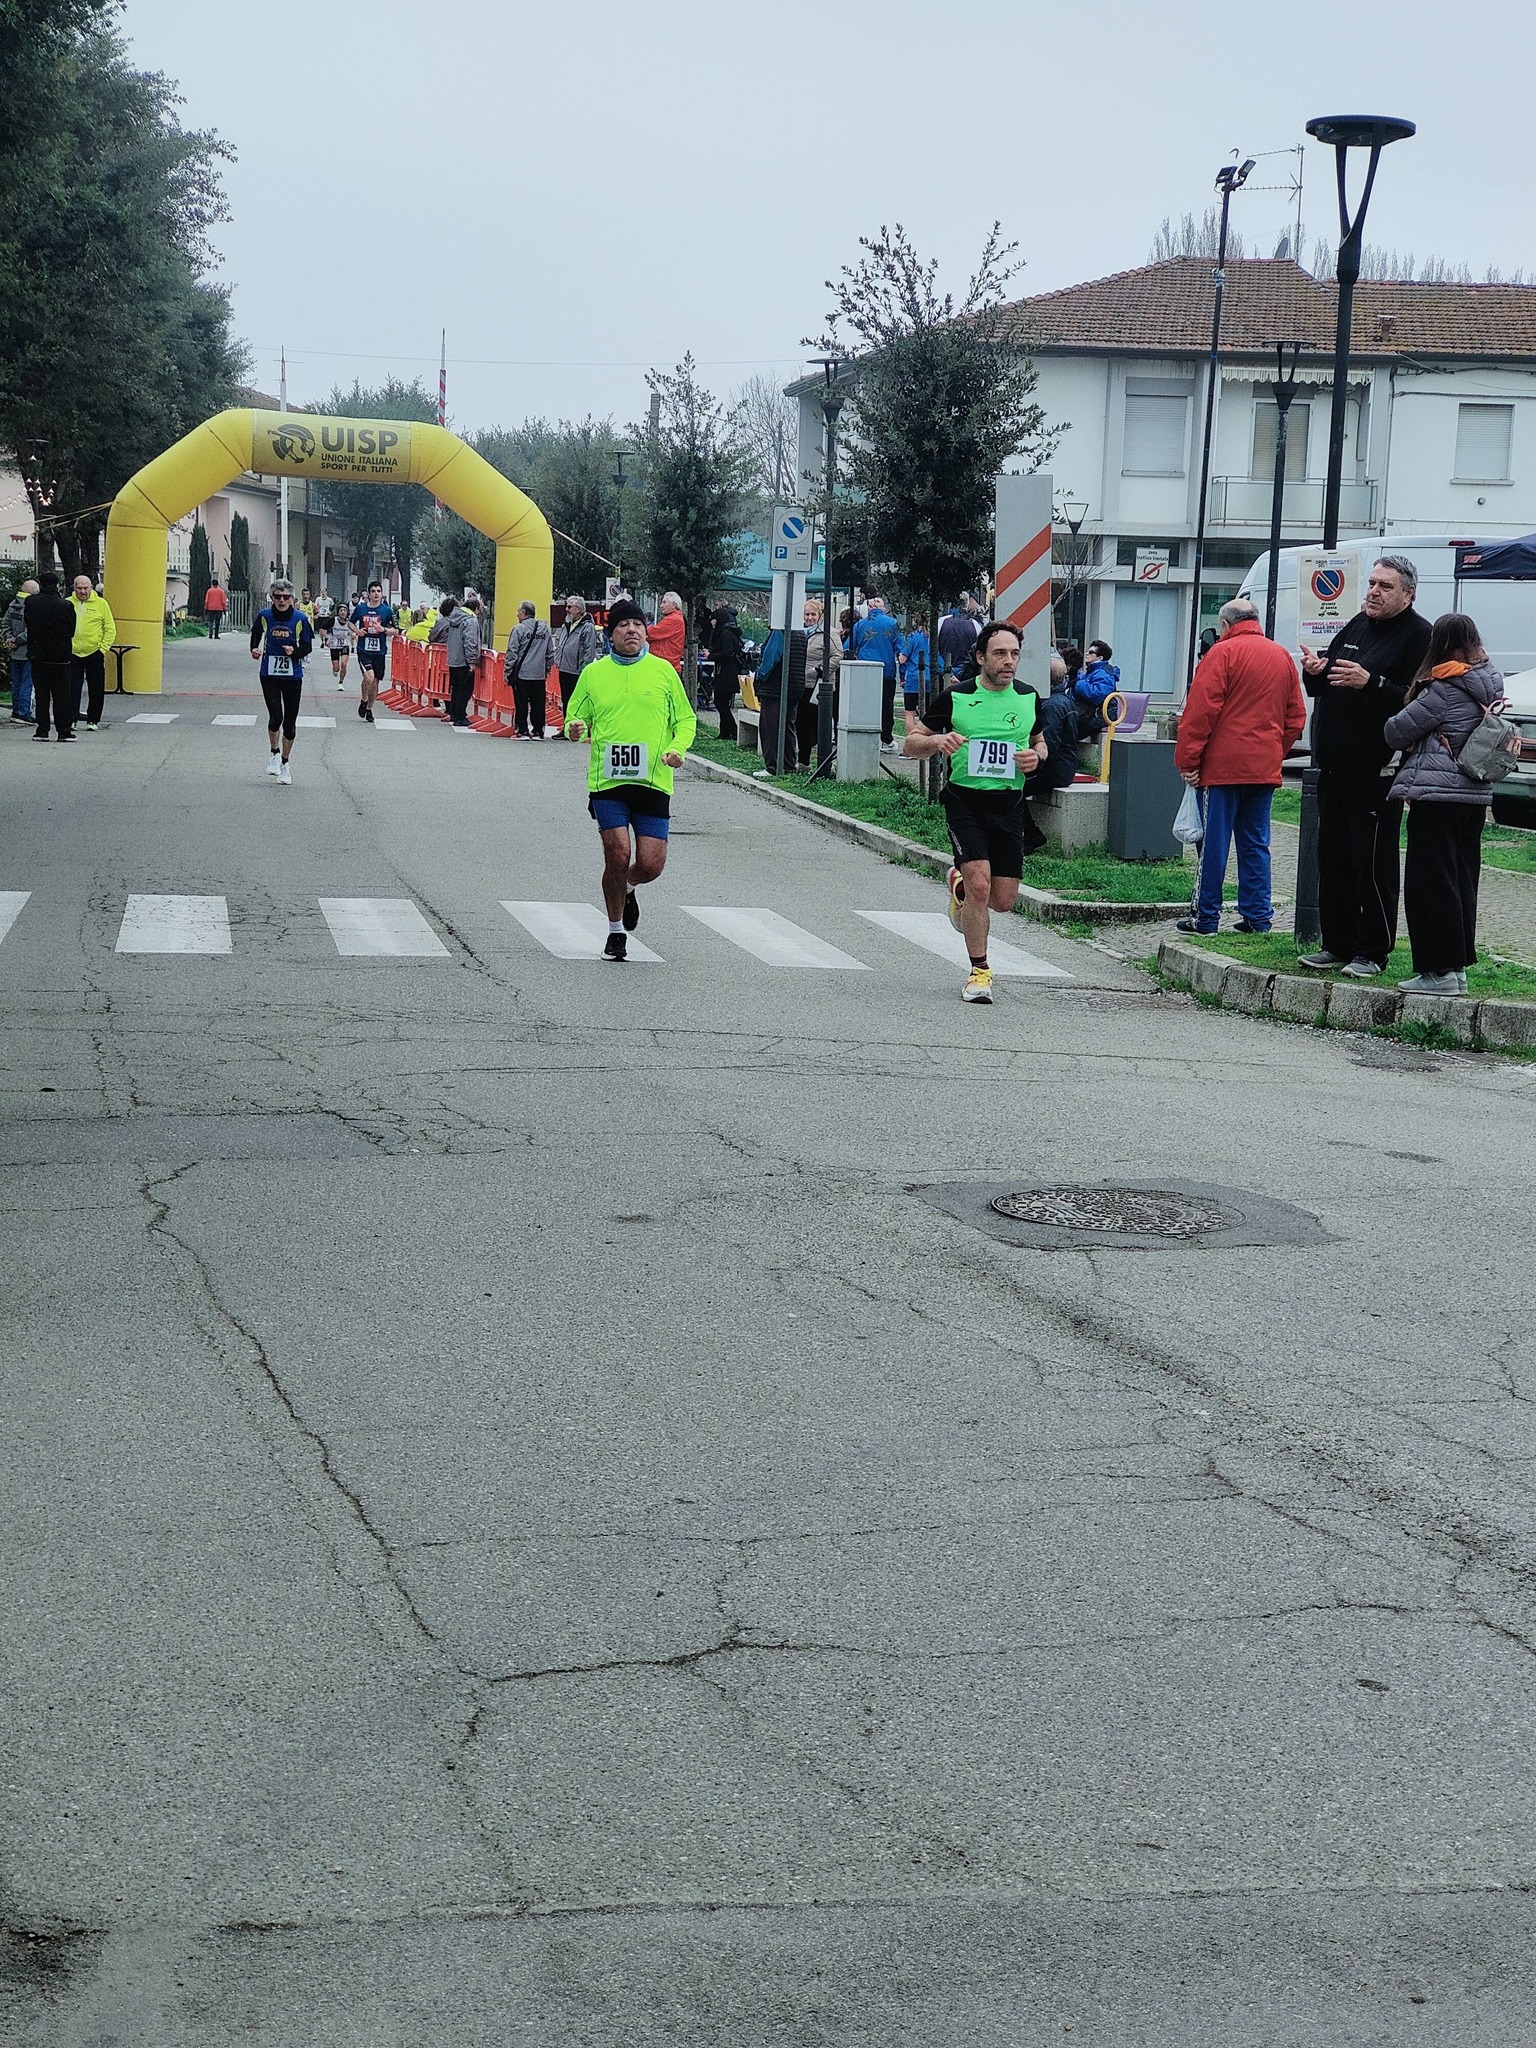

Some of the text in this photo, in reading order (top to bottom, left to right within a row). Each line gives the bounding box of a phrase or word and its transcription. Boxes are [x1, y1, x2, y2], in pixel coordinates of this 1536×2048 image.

[322, 426, 399, 454] UISP
[321, 453, 398, 467] UNIONE ITALIANA
[321, 462, 393, 474] SPORT PER TUTTI
[776, 547, 786, 558] P
[367, 638, 379, 647] 733
[273, 656, 290, 669] 725
[611, 745, 640, 767] 550
[979, 741, 1008, 765] 799
